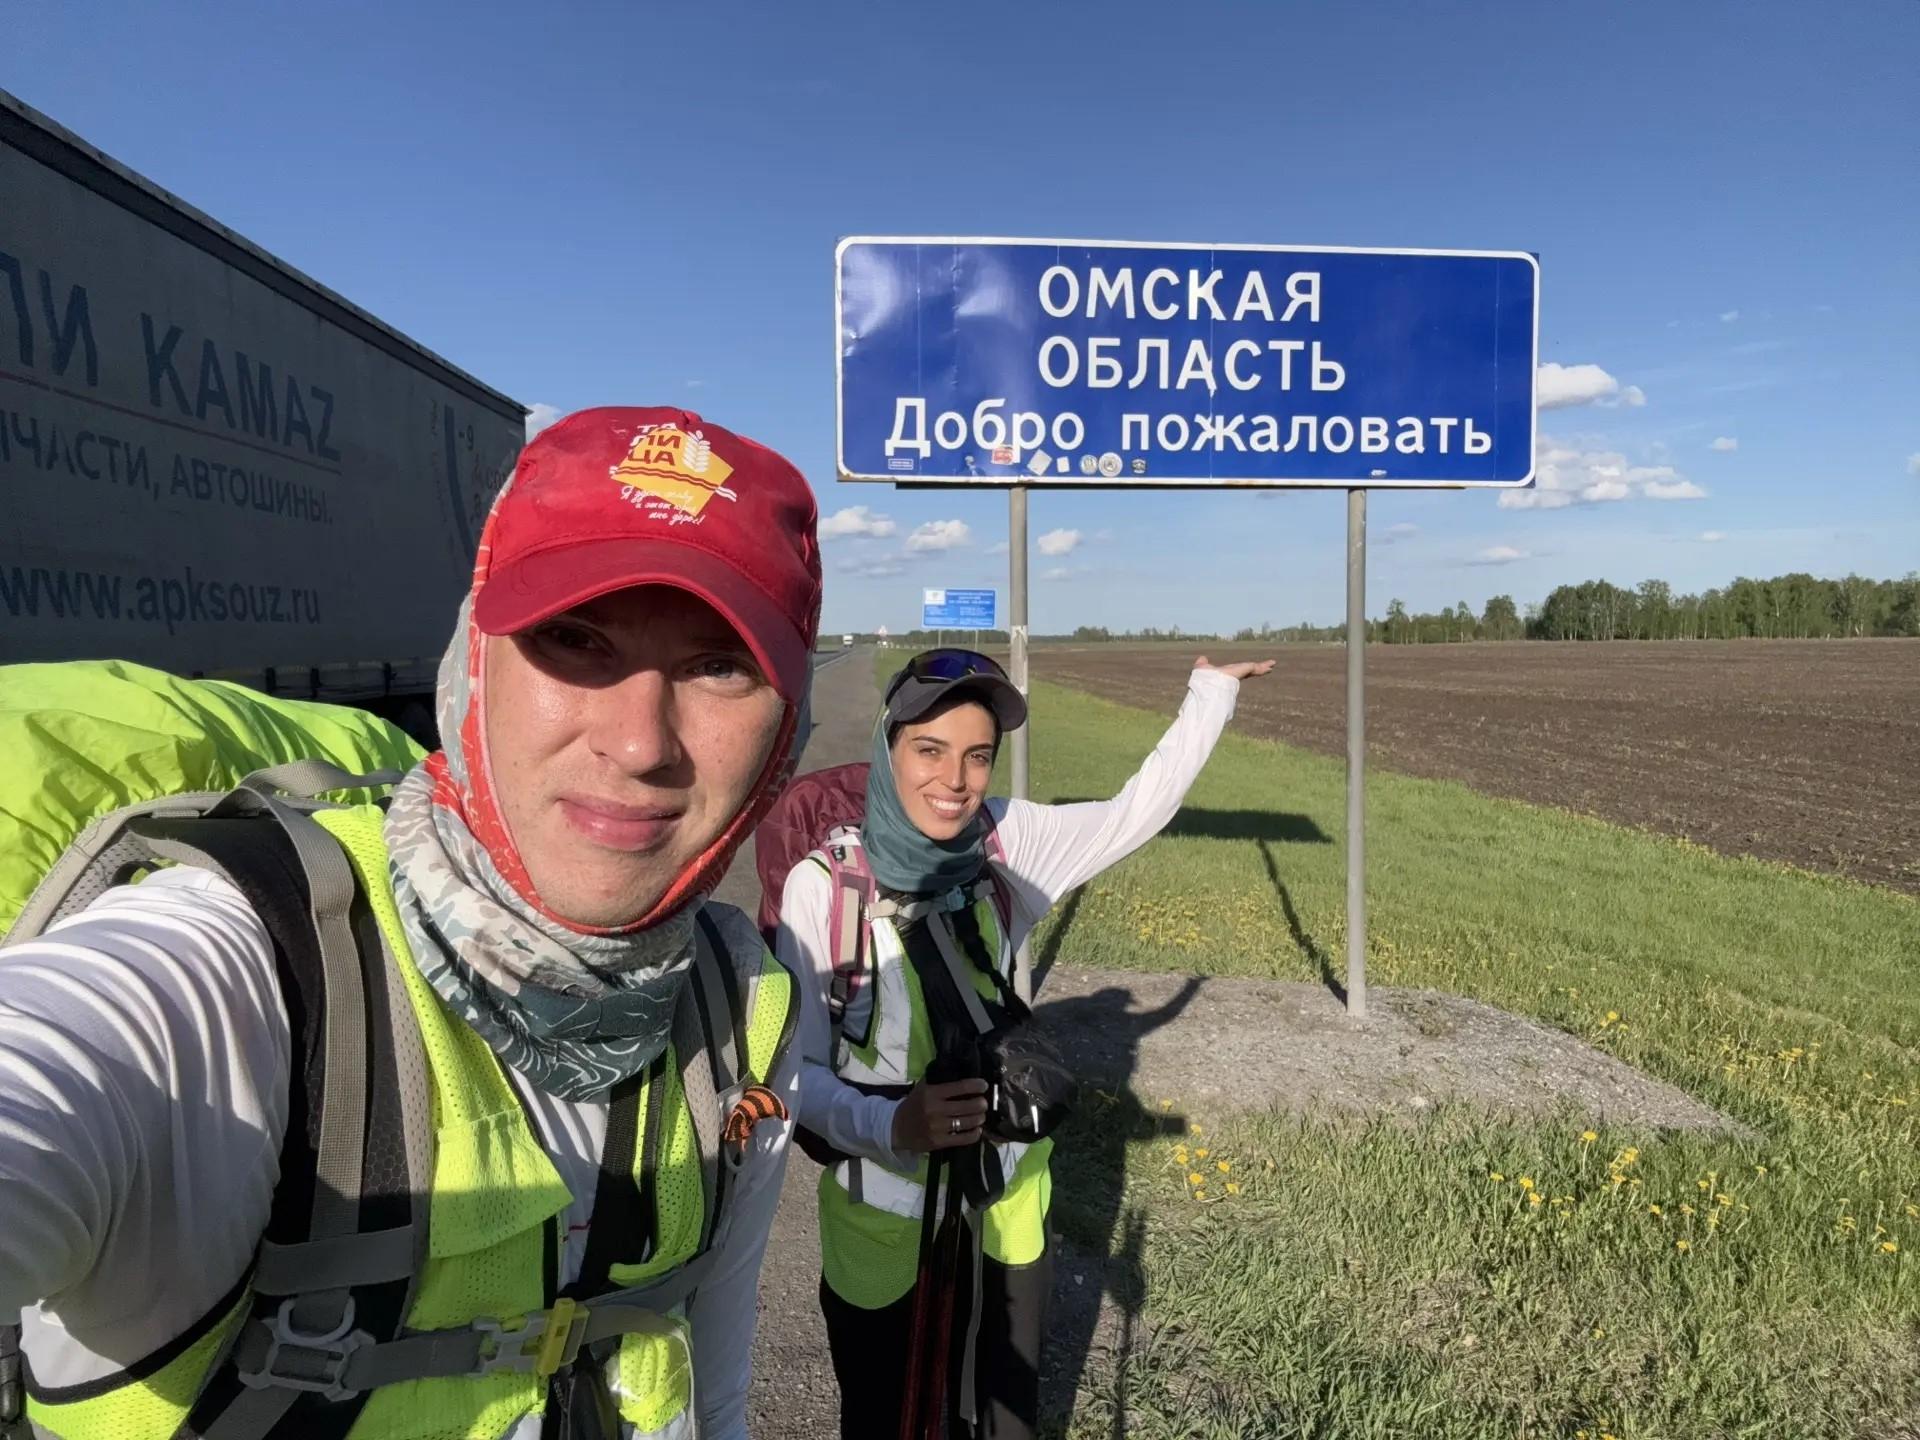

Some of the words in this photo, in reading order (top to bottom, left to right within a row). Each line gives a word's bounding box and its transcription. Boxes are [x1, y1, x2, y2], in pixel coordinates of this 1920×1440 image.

[1038, 266, 1321, 323] ОМСКАЯ
[140, 312, 342, 463] KAMAZ
[1038, 335, 1346, 392] ОБЛАСТЬ
[0, 409, 161, 502] ЧАСТИ,
[627, 449, 676, 466] ЦА
[884, 397, 1085, 463] Добро
[1121, 413, 1492, 454] пожаловать
[0, 565, 321, 636] www.apksouz.ru
